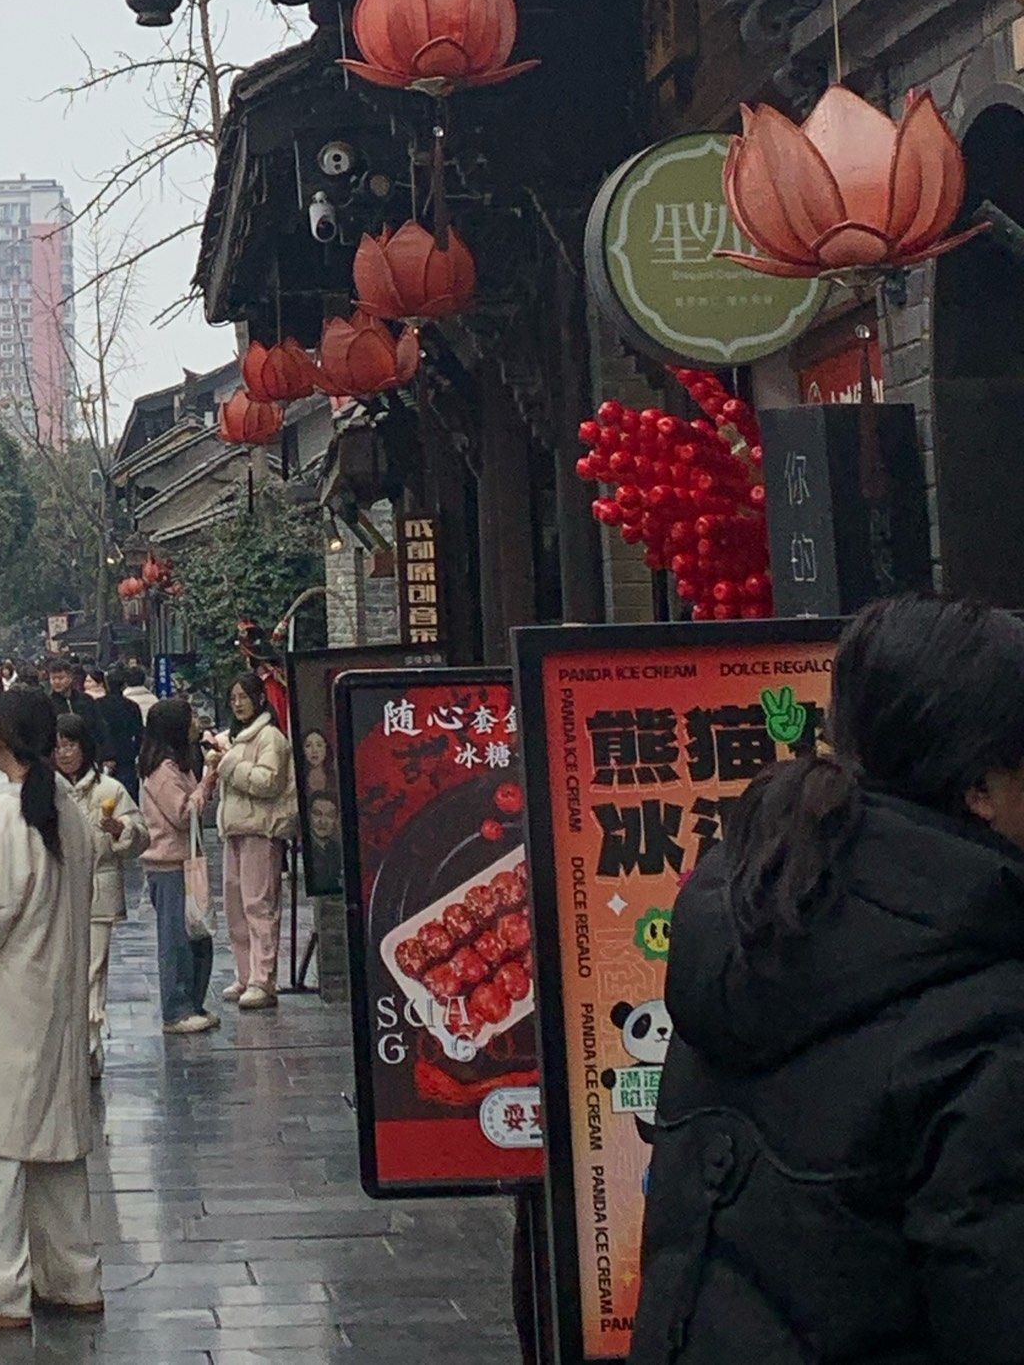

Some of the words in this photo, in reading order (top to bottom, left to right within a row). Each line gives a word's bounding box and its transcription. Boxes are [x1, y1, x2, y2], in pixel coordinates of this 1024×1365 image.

[405, 519, 437, 644] 成都原创音乐
[558, 668, 612, 682] PANDA
[616, 666, 640, 680] ICE
[642, 664, 697, 679] CREAM
[720, 662, 770, 677] DOLCE
[560, 688, 576, 744] PANDA
[454, 741, 520, 769] 冰糖
[563, 747, 578, 773] ICE
[566, 775, 582, 833] CREAM
[571, 857, 587, 910] DOLCE
[576, 913, 592, 978] REGALO
[581, 1002, 597, 1061] PANDA
[584, 1064, 599, 1089] ICE
[586, 1091, 603, 1151] CREAM
[591, 1165, 607, 1223] PANDA
[595, 1227, 609, 1253] ICE
[597, 1255, 613, 1315] CREAM
